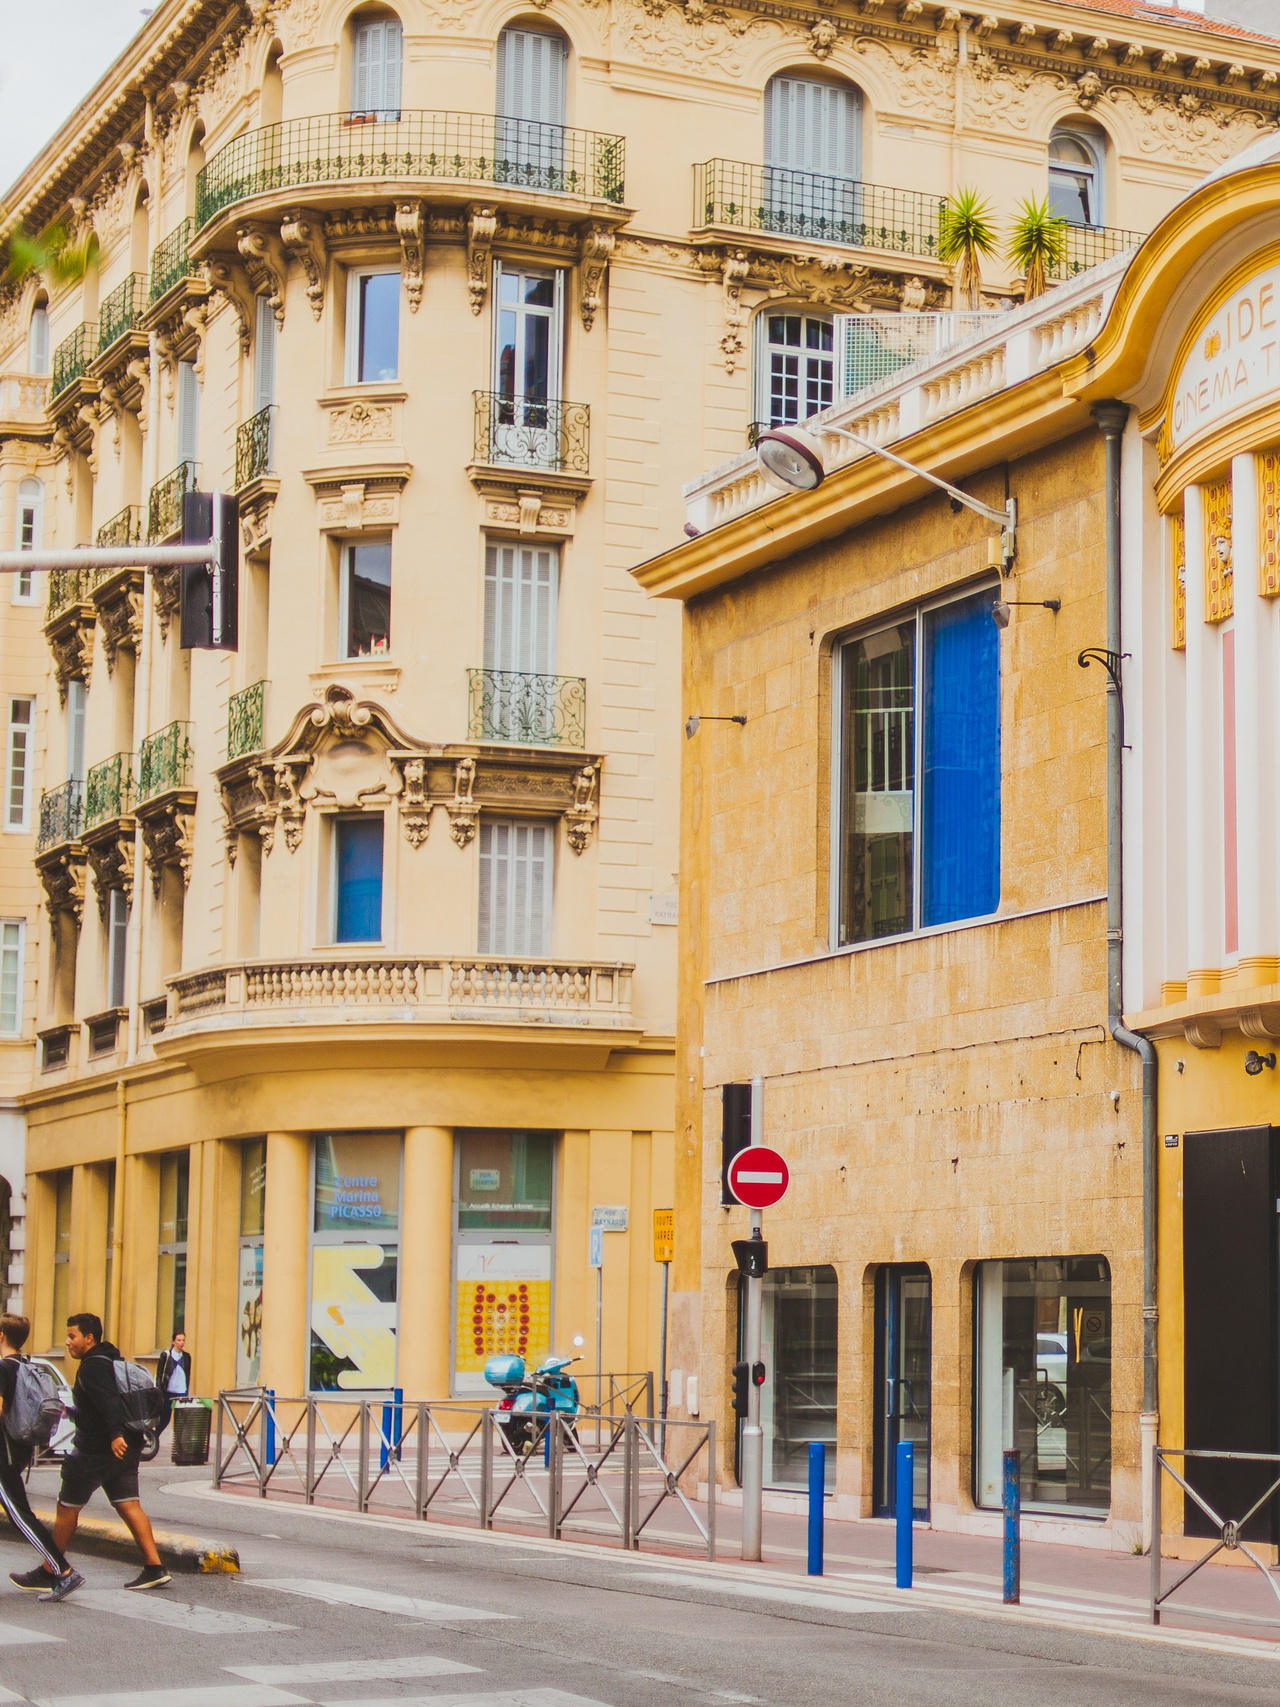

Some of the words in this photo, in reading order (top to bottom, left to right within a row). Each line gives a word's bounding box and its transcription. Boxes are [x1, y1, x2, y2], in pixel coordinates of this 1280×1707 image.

[1173, 357, 1250, 433] CINEMA
[335, 1174, 378, 1188] Centre
[334, 1189, 380, 1203] Marina
[331, 1204, 383, 1218] PICASSO
